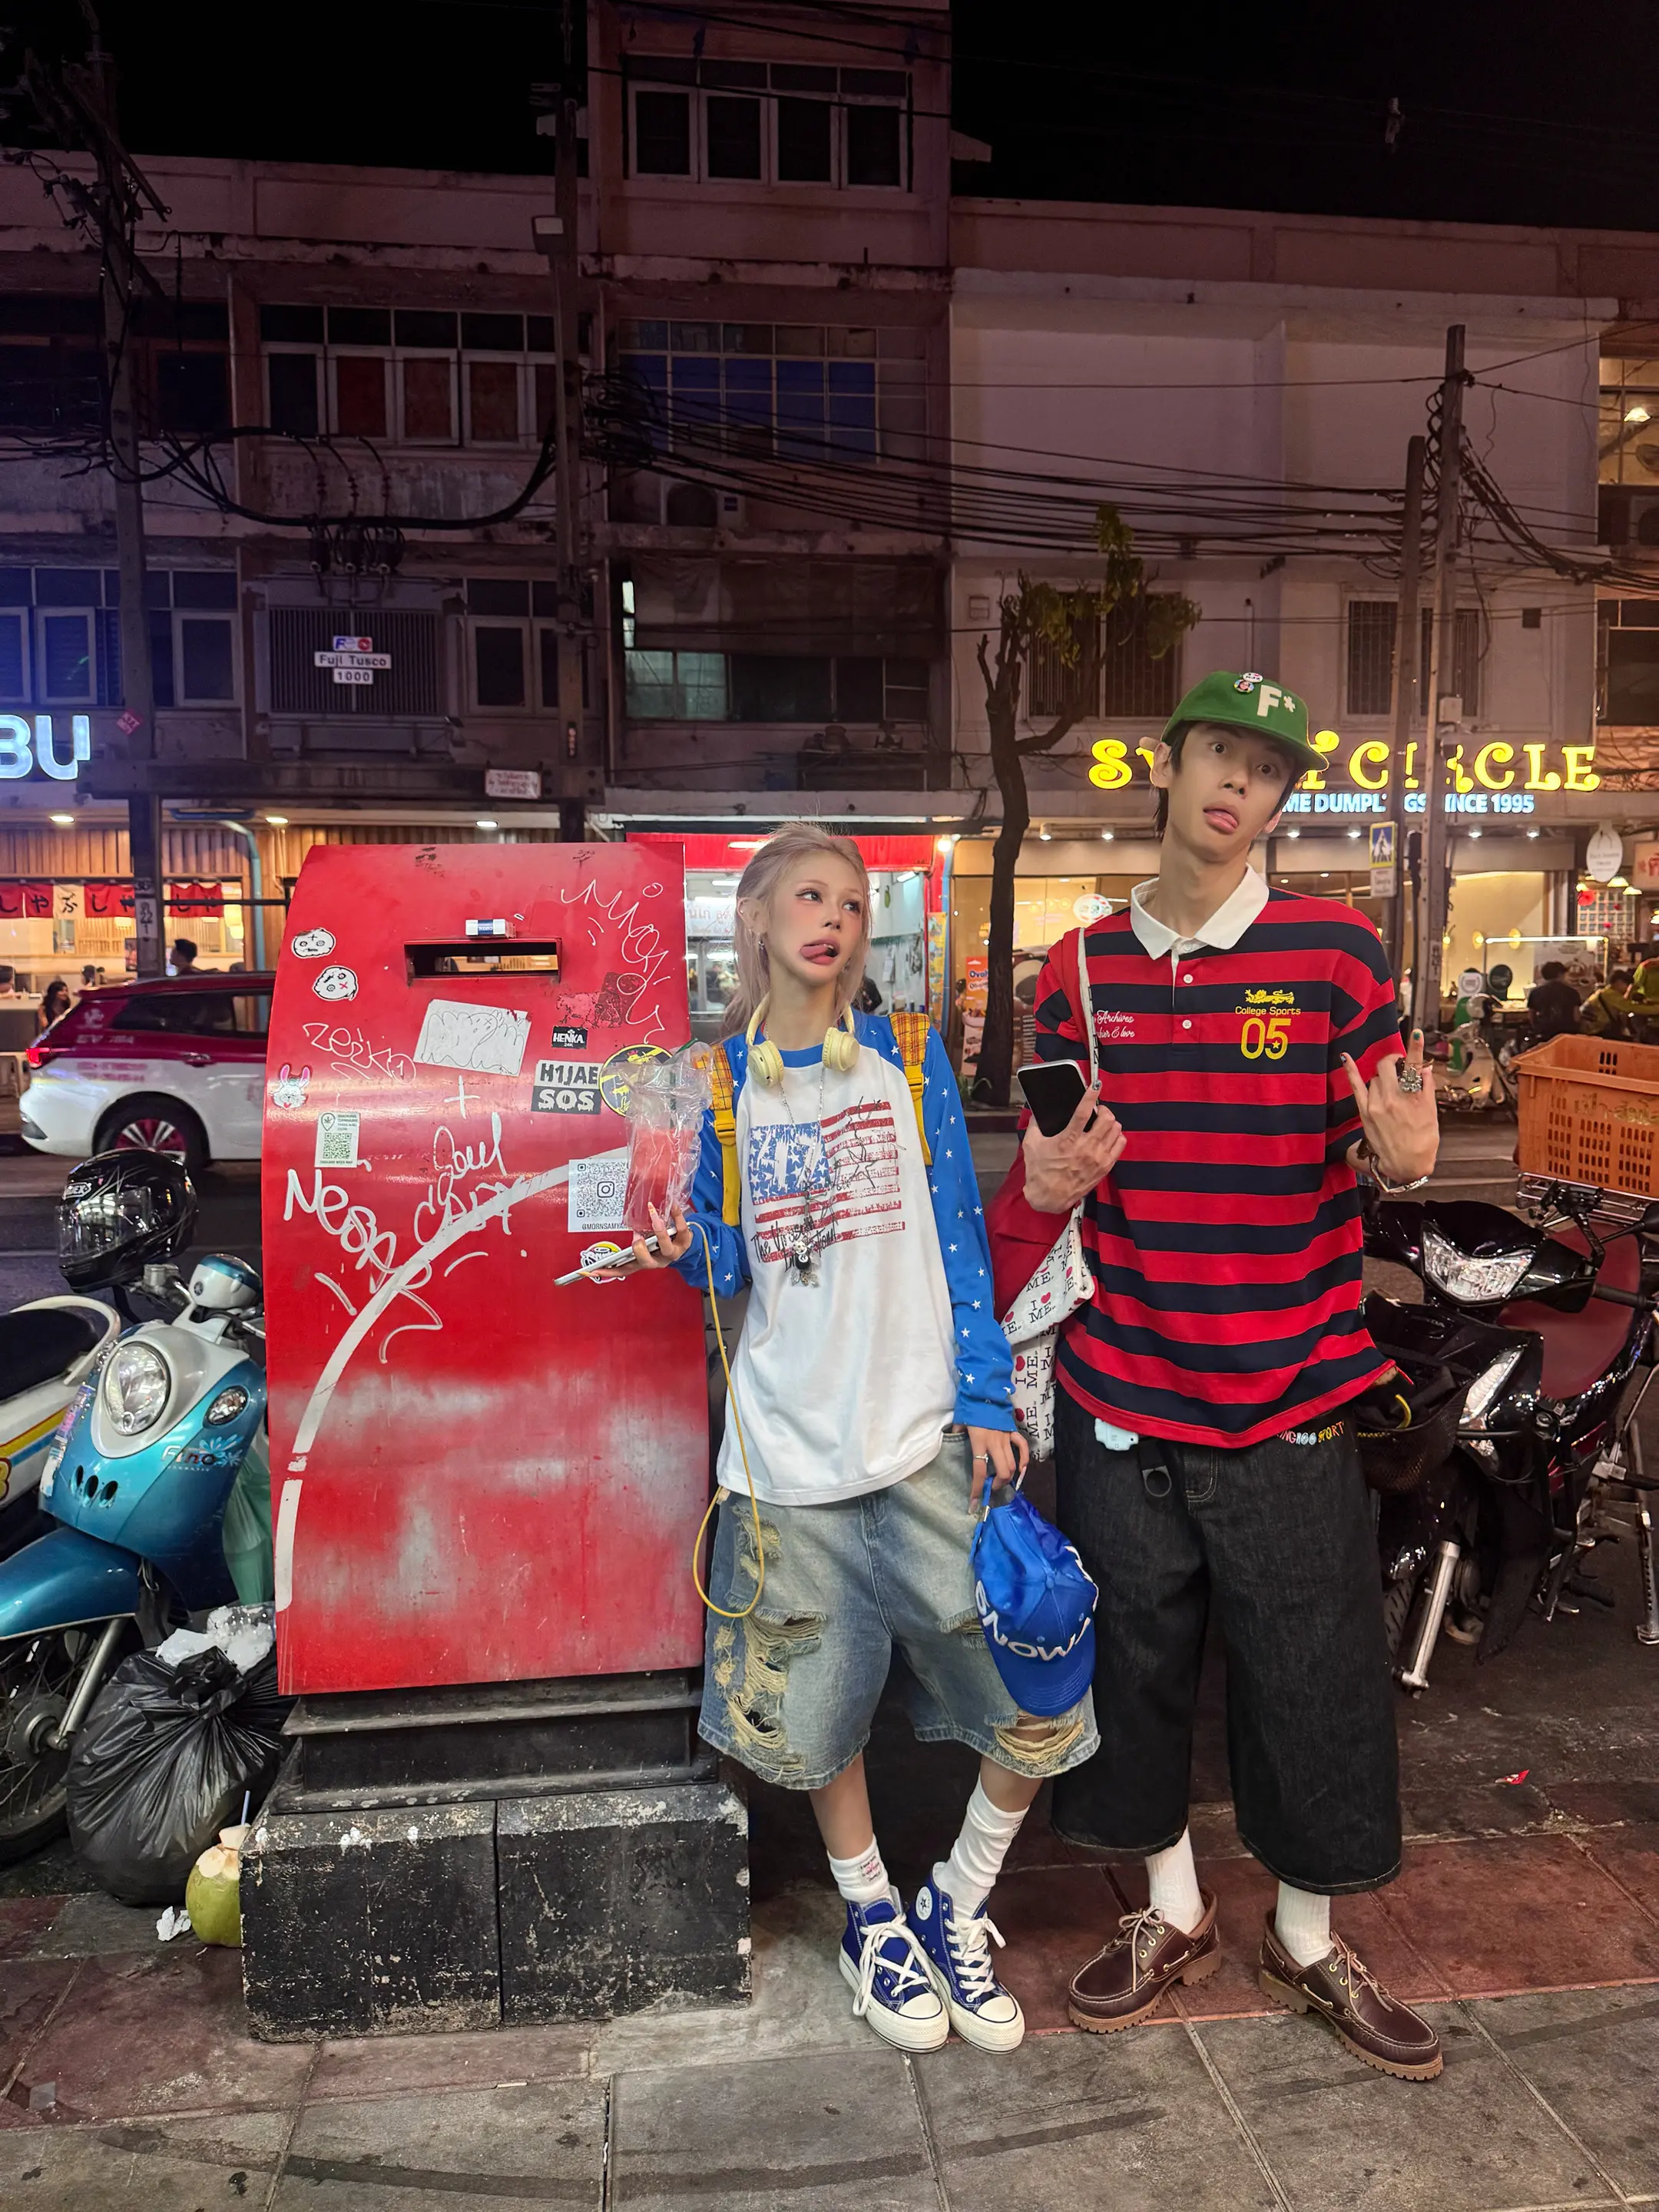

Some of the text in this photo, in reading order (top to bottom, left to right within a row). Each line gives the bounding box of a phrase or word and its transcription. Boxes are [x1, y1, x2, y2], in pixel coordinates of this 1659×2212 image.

[320, 654, 387, 667] Fuji Tusco
[337, 671, 370, 682] 1000
[1314, 793, 1426, 813] DUMPLGS
[1444, 793, 1488, 813] INCE
[1491, 793, 1535, 813] 1995
[1235, 1005, 1301, 1016] College Sports
[553, 1032, 584, 1044] HENKA
[1240, 1018, 1292, 1060] 05
[540, 1062, 598, 1086] H1JAE
[538, 1088, 595, 1111] SOS
[161, 1445, 216, 1465] Fino
